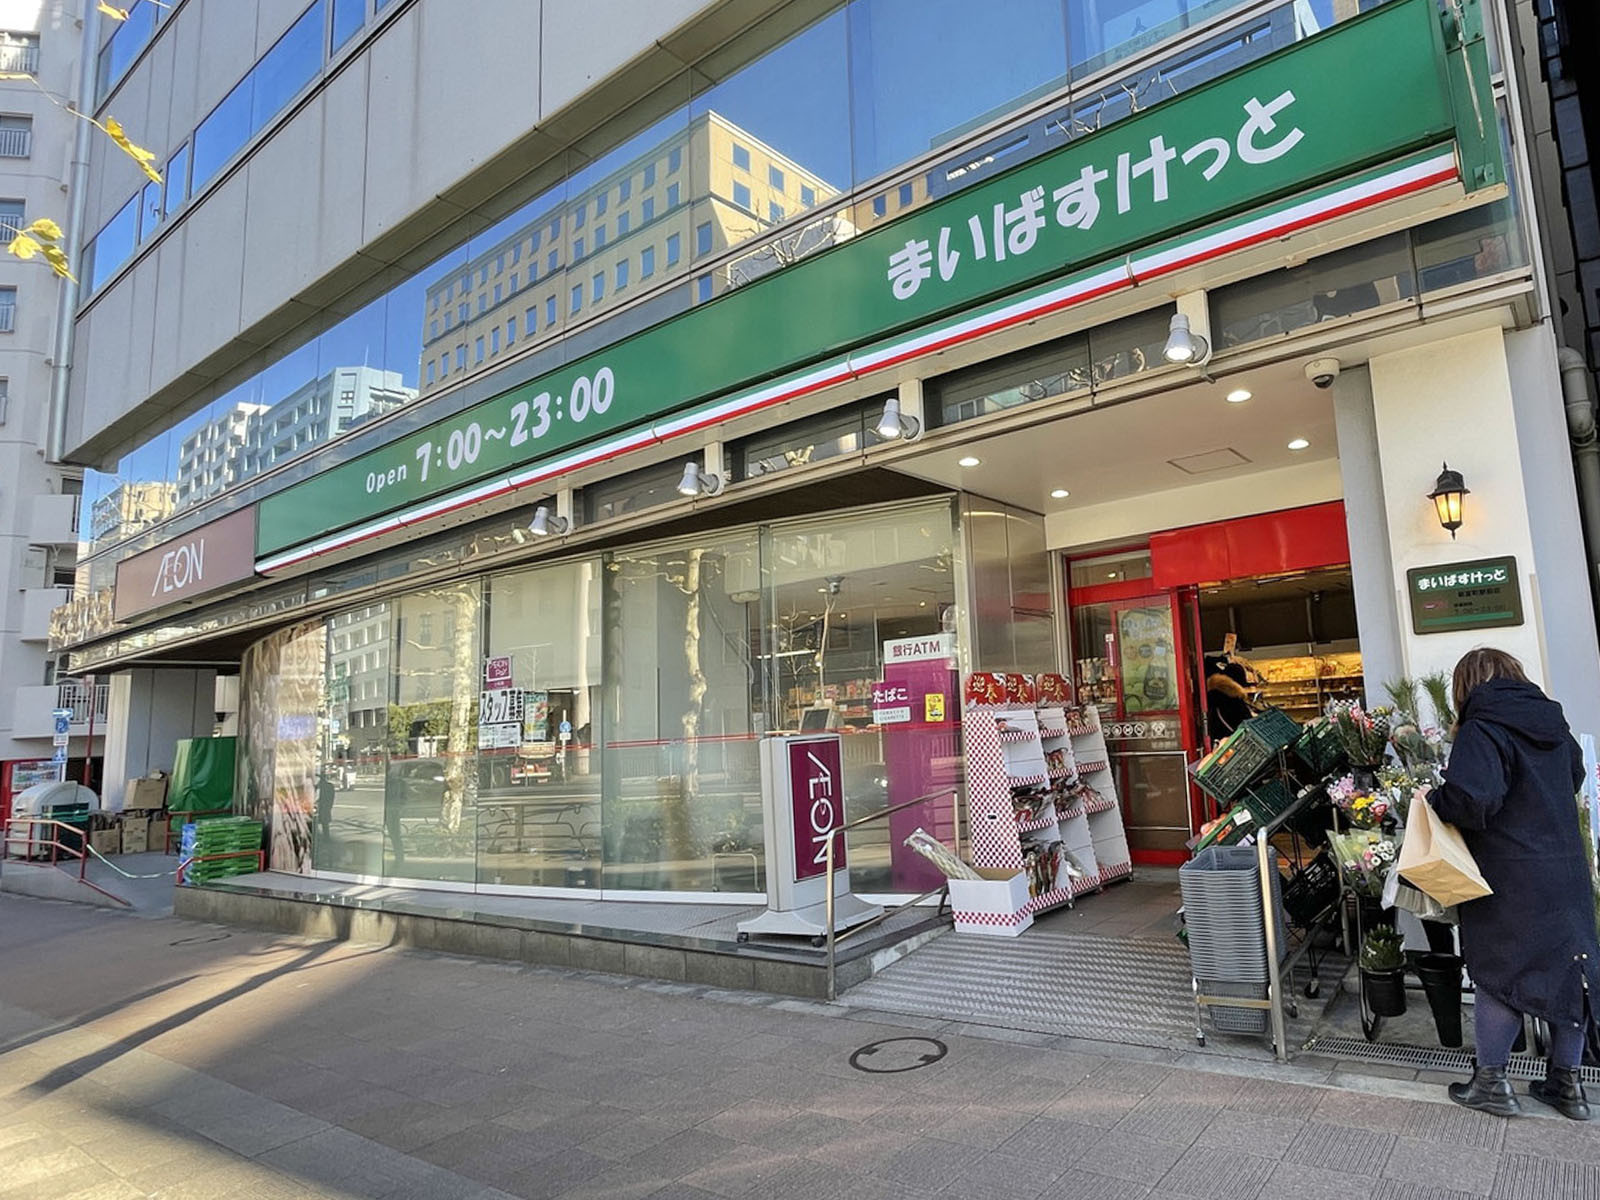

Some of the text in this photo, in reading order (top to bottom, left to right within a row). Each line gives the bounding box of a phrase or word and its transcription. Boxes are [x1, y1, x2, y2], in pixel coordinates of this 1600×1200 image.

[887, 90, 1305, 300] まいばすけっと
[366, 464, 407, 494] Open
[1418, 569, 1506, 590] まいばすけっと
[892, 640, 941, 658] 銀行ATM
[872, 687, 908, 703] たばこ
